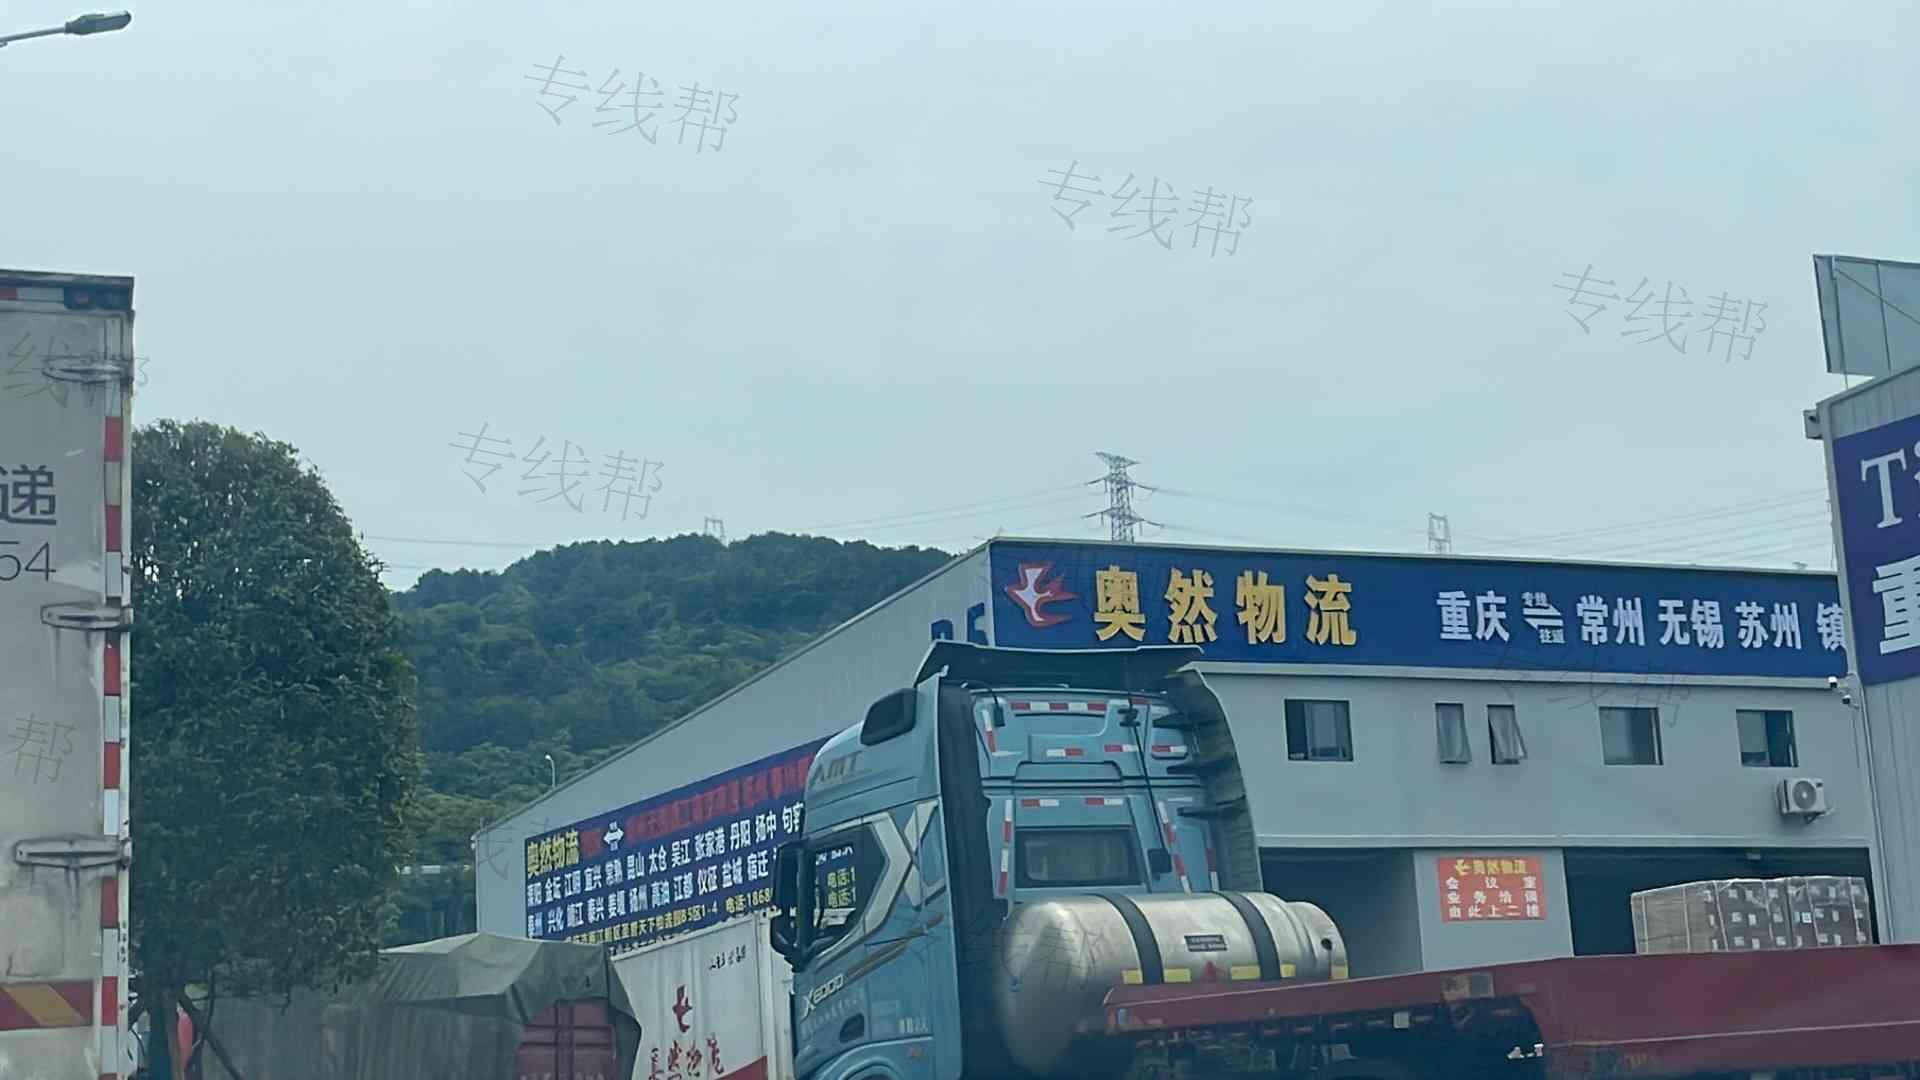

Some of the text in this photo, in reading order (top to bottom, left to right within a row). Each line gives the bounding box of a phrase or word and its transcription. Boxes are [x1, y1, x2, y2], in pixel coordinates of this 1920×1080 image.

[0, 465, 57, 526] 递
[1861, 441, 1920, 529] T
[0, 541, 56, 583] 54
[1094, 564, 1358, 646] 奥然物流
[1436, 590, 1510, 642] 重庆
[1576, 594, 1646, 646] 常州
[1658, 598, 1725, 649] 无锡
[1735, 601, 1802, 650] 苏州
[671, 838, 691, 868] 吴江
[730, 819, 751, 851] 丹阳
